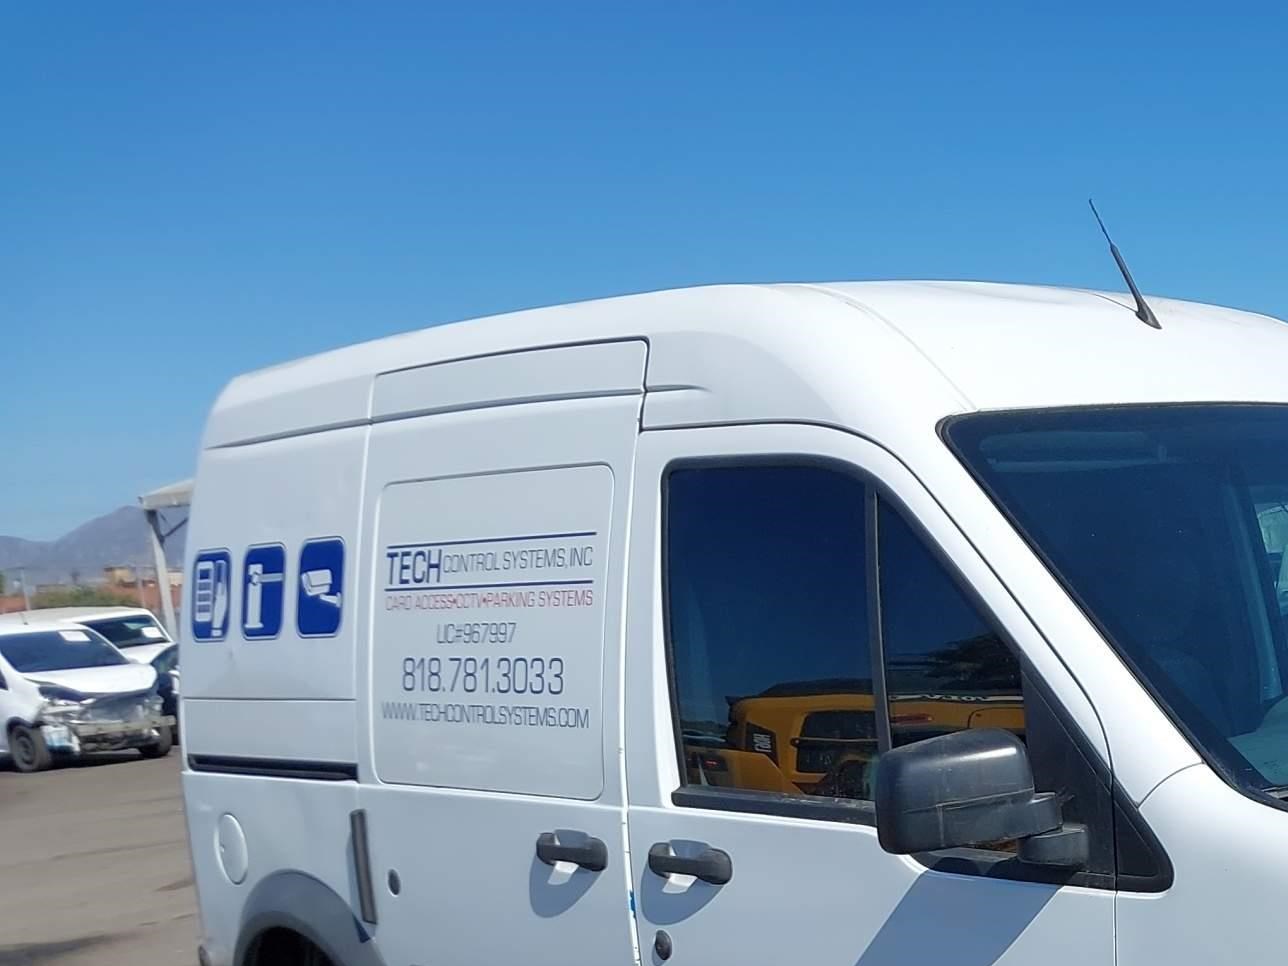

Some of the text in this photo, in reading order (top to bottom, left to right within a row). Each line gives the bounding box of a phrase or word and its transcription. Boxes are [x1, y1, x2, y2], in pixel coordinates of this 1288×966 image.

[387, 548, 442, 584] TECH
[443, 553, 500, 572] CONTROL
[569, 546, 593, 567] INC
[538, 590, 593, 606] SYSTEMS
[402, 657, 564, 695] 818.781.3033
[381, 702, 590, 729] WWW.TECHCONTROLSYSTEMS.COM
